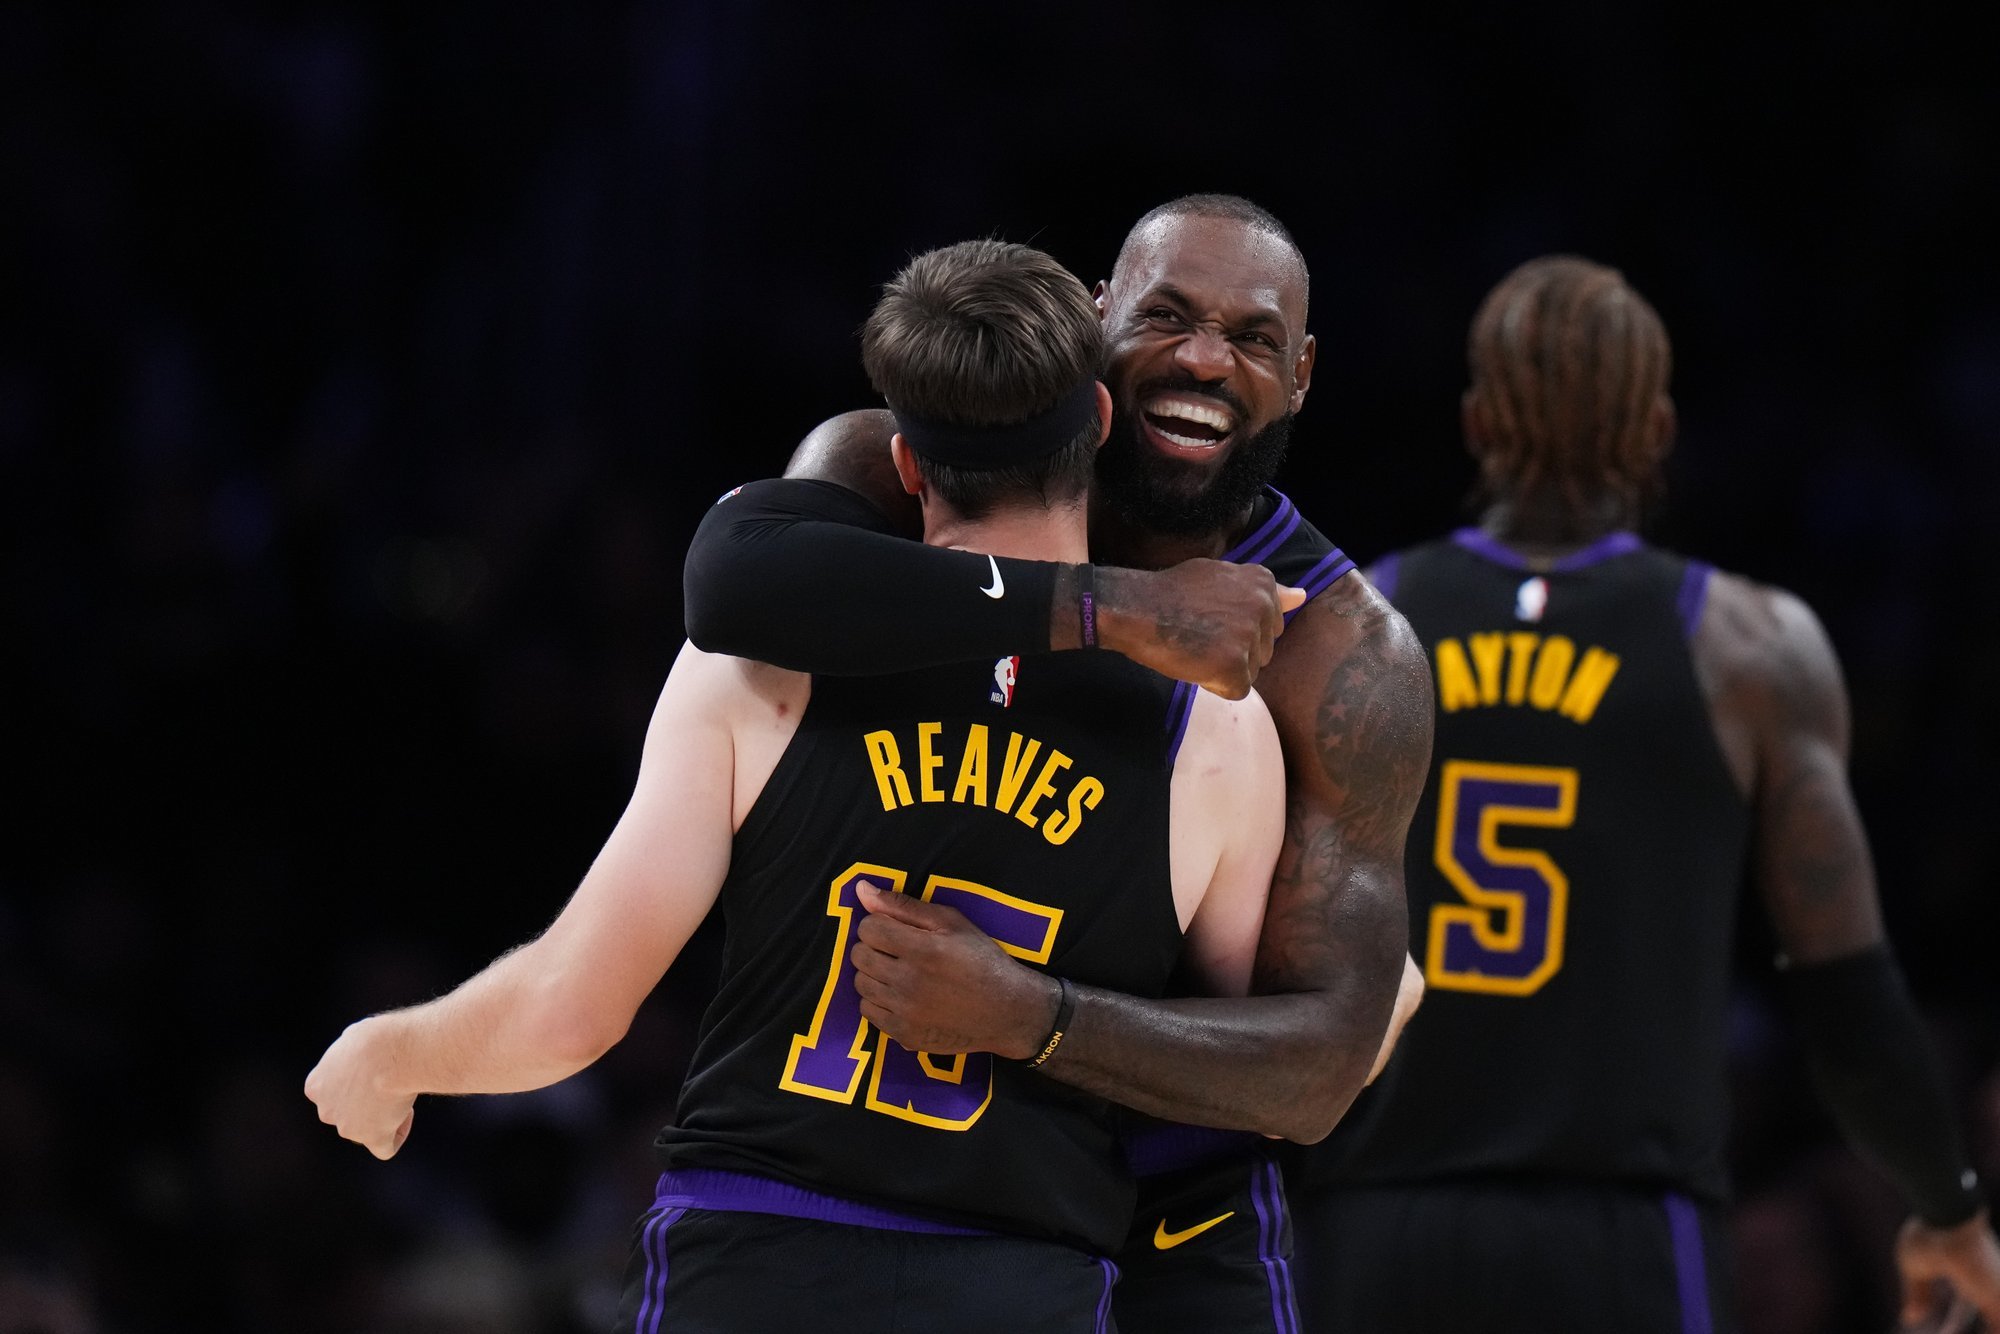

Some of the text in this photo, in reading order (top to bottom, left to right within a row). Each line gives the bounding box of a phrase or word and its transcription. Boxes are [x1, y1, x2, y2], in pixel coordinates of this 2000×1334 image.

[1083, 598, 1094, 645] PROMISE
[991, 692, 1003, 703] NBA
[1435, 632, 1620, 724] AYTON
[863, 721, 1105, 846] REAVES
[1425, 758, 1580, 998] 5
[778, 861, 1065, 1132] 15
[1036, 1032, 1063, 1064] AKRON
